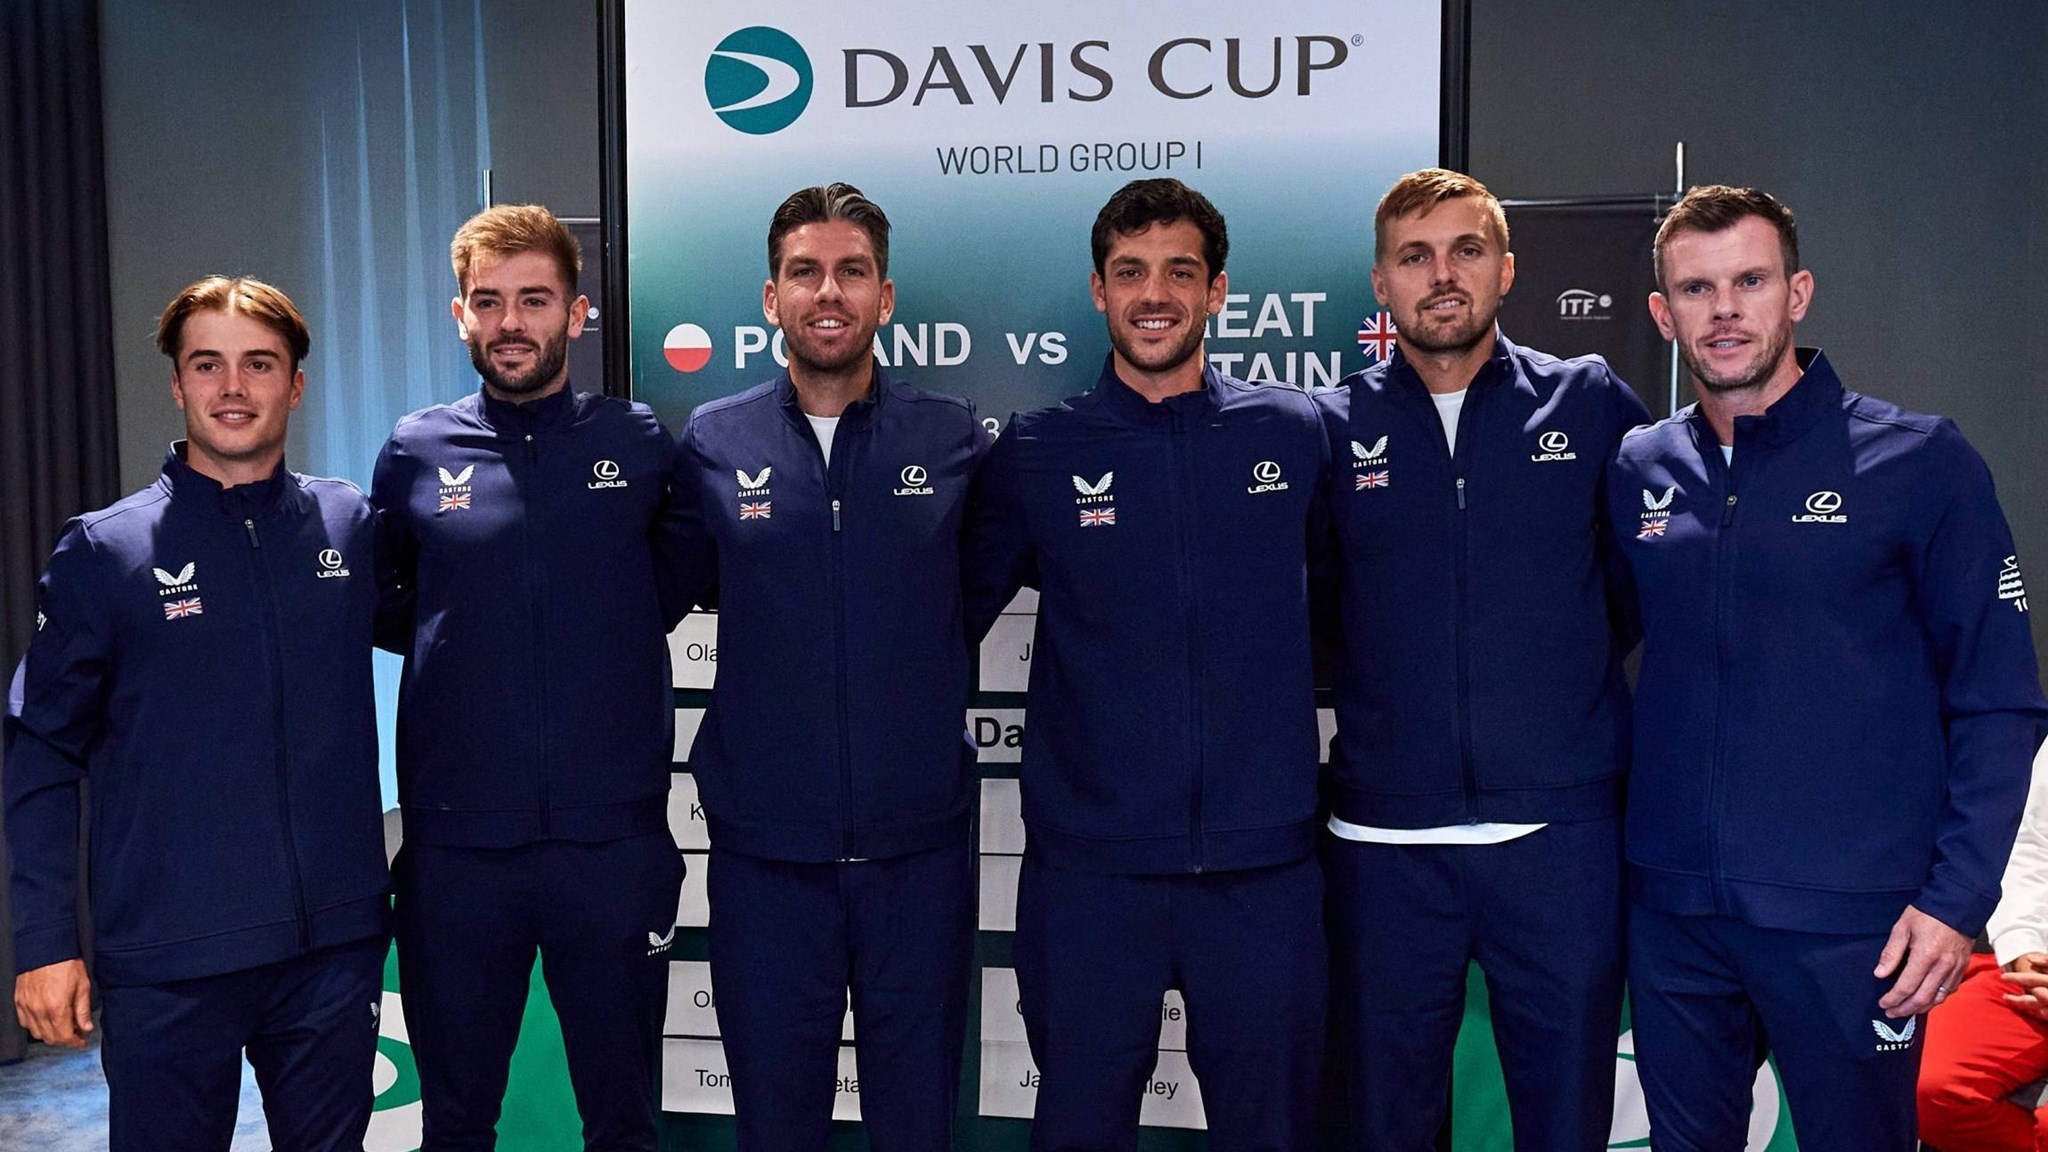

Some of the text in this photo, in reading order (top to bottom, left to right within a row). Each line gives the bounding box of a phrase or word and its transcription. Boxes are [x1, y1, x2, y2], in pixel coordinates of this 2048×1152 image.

[841, 40, 1114, 108] DAVIS
[1147, 35, 1349, 100] CUP
[936, 144, 1059, 175] WORLD
[1069, 141, 1186, 173] GROUP
[1560, 298, 1596, 316] ITF
[1204, 292, 1327, 339] EAT
[1531, 452, 1577, 462] LEXUS
[587, 480, 628, 490] LEXUS
[1247, 481, 1289, 494] LEXUS
[893, 486, 935, 496] LEXUS
[1075, 495, 1114, 505] CASTORE
[1791, 514, 1848, 524] LEXUS
[316, 568, 350, 579] LEXUS
[159, 584, 198, 596] CASTORE
